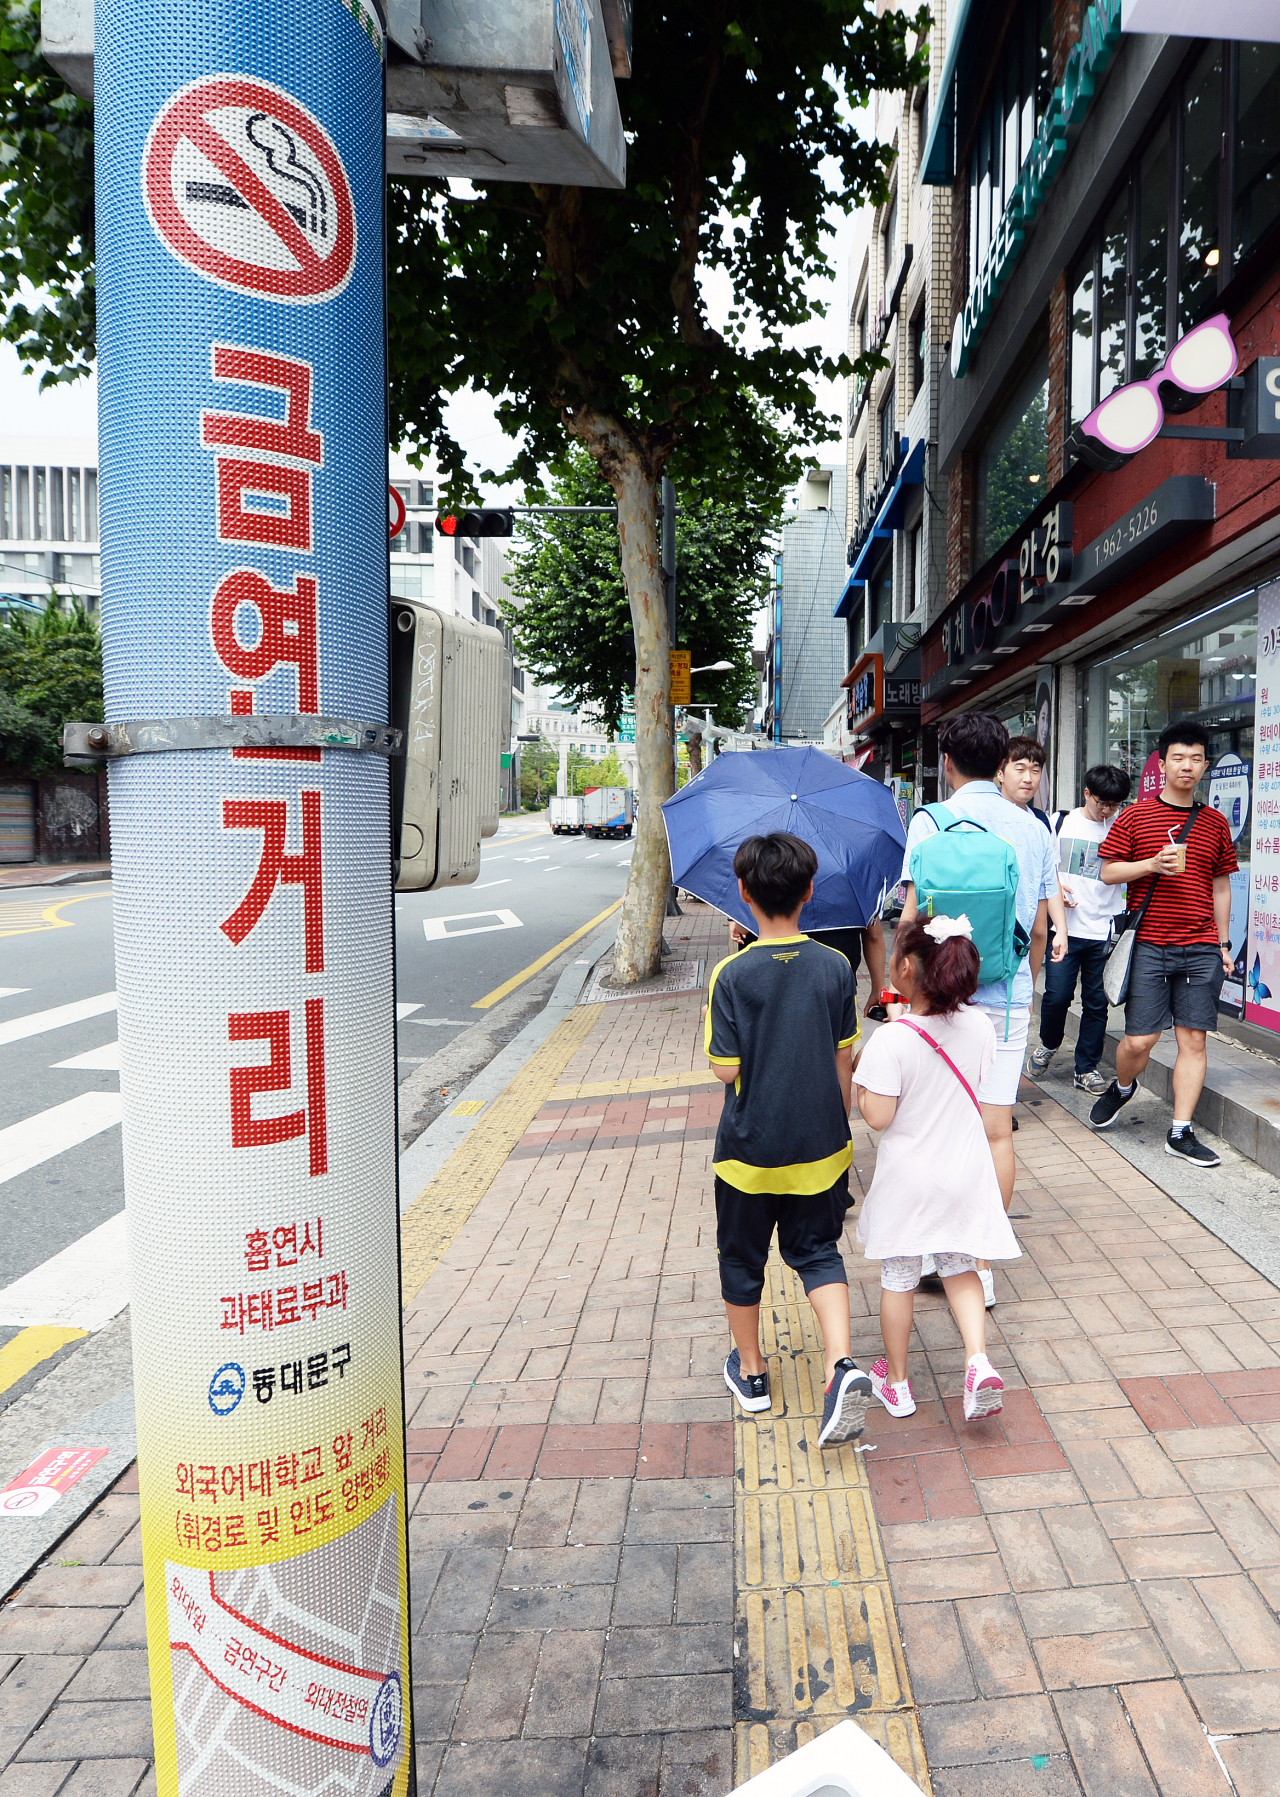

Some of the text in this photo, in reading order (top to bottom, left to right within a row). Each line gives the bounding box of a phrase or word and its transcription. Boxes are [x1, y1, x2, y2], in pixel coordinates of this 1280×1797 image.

[963, 187, 1016, 347] COFFEE
[1019, 502, 1060, 604] 안경
[1094, 501, 1158, 567] T.962-5226
[886, 682, 921, 705] 노래방
[1261, 687, 1268, 704] 원
[1143, 771, 1157, 792] 렌즈
[1257, 799, 1280, 817] 아이리스
[1256, 837, 1280, 854] 바슈롬
[1255, 874, 1279, 892] 난시용
[243, 1217, 324, 1272] 흡연시
[219, 1270, 349, 1335] 과태료부과
[252, 1343, 352, 1403] 동대문구
[27, 1450, 80, 1486] 금연구역
[176, 1401, 388, 1504] 외국어대학교 앞 거리
[257, 1506, 280, 1546] 및
[290, 1489, 335, 1536] 인도
[223, 1636, 288, 1693] 금연구간
